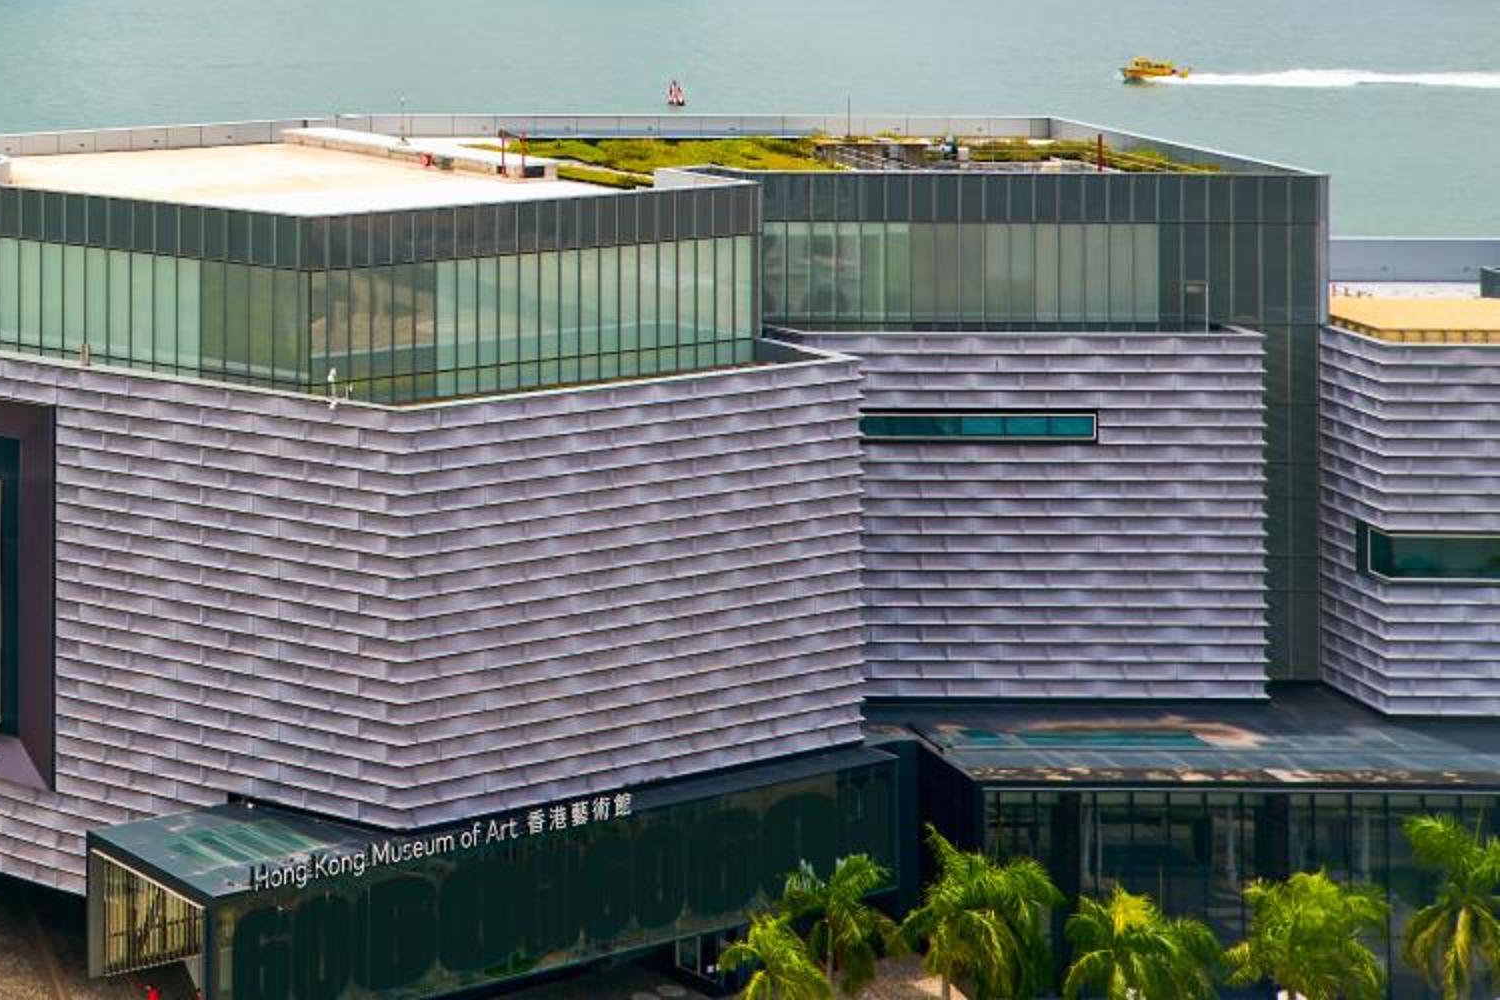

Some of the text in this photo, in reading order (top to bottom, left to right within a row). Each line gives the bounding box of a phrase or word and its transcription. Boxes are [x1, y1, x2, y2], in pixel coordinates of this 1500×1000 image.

[254, 792, 633, 892] Hong Kong Museum of Art 香港藝術館
